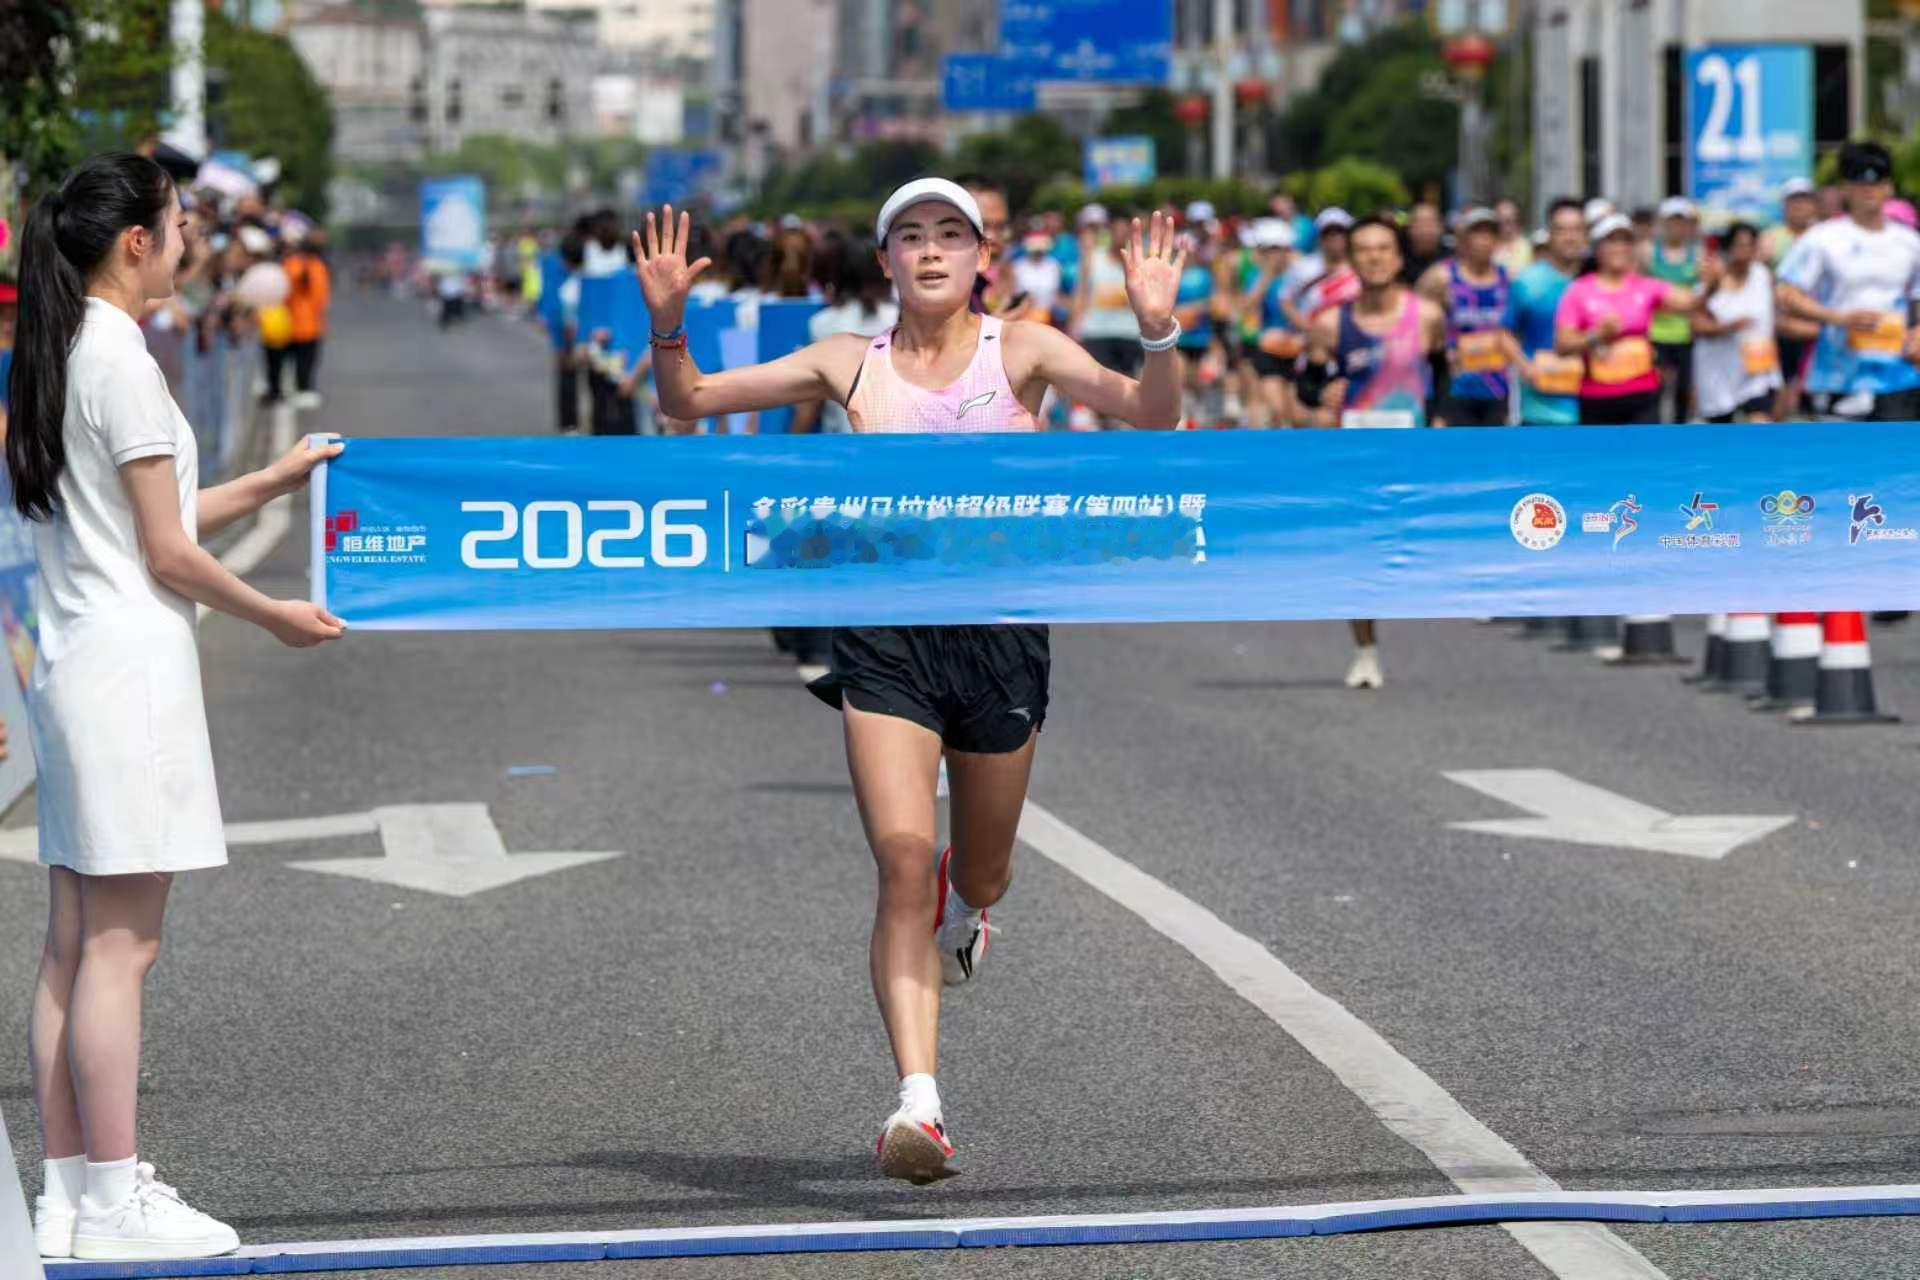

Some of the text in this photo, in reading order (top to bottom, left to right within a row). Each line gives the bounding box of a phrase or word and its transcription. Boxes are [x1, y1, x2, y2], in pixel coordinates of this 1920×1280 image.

[1697, 54, 1763, 160] 21
[343, 535, 426, 552] 恒维地产
[460, 500, 707, 568] 2026
